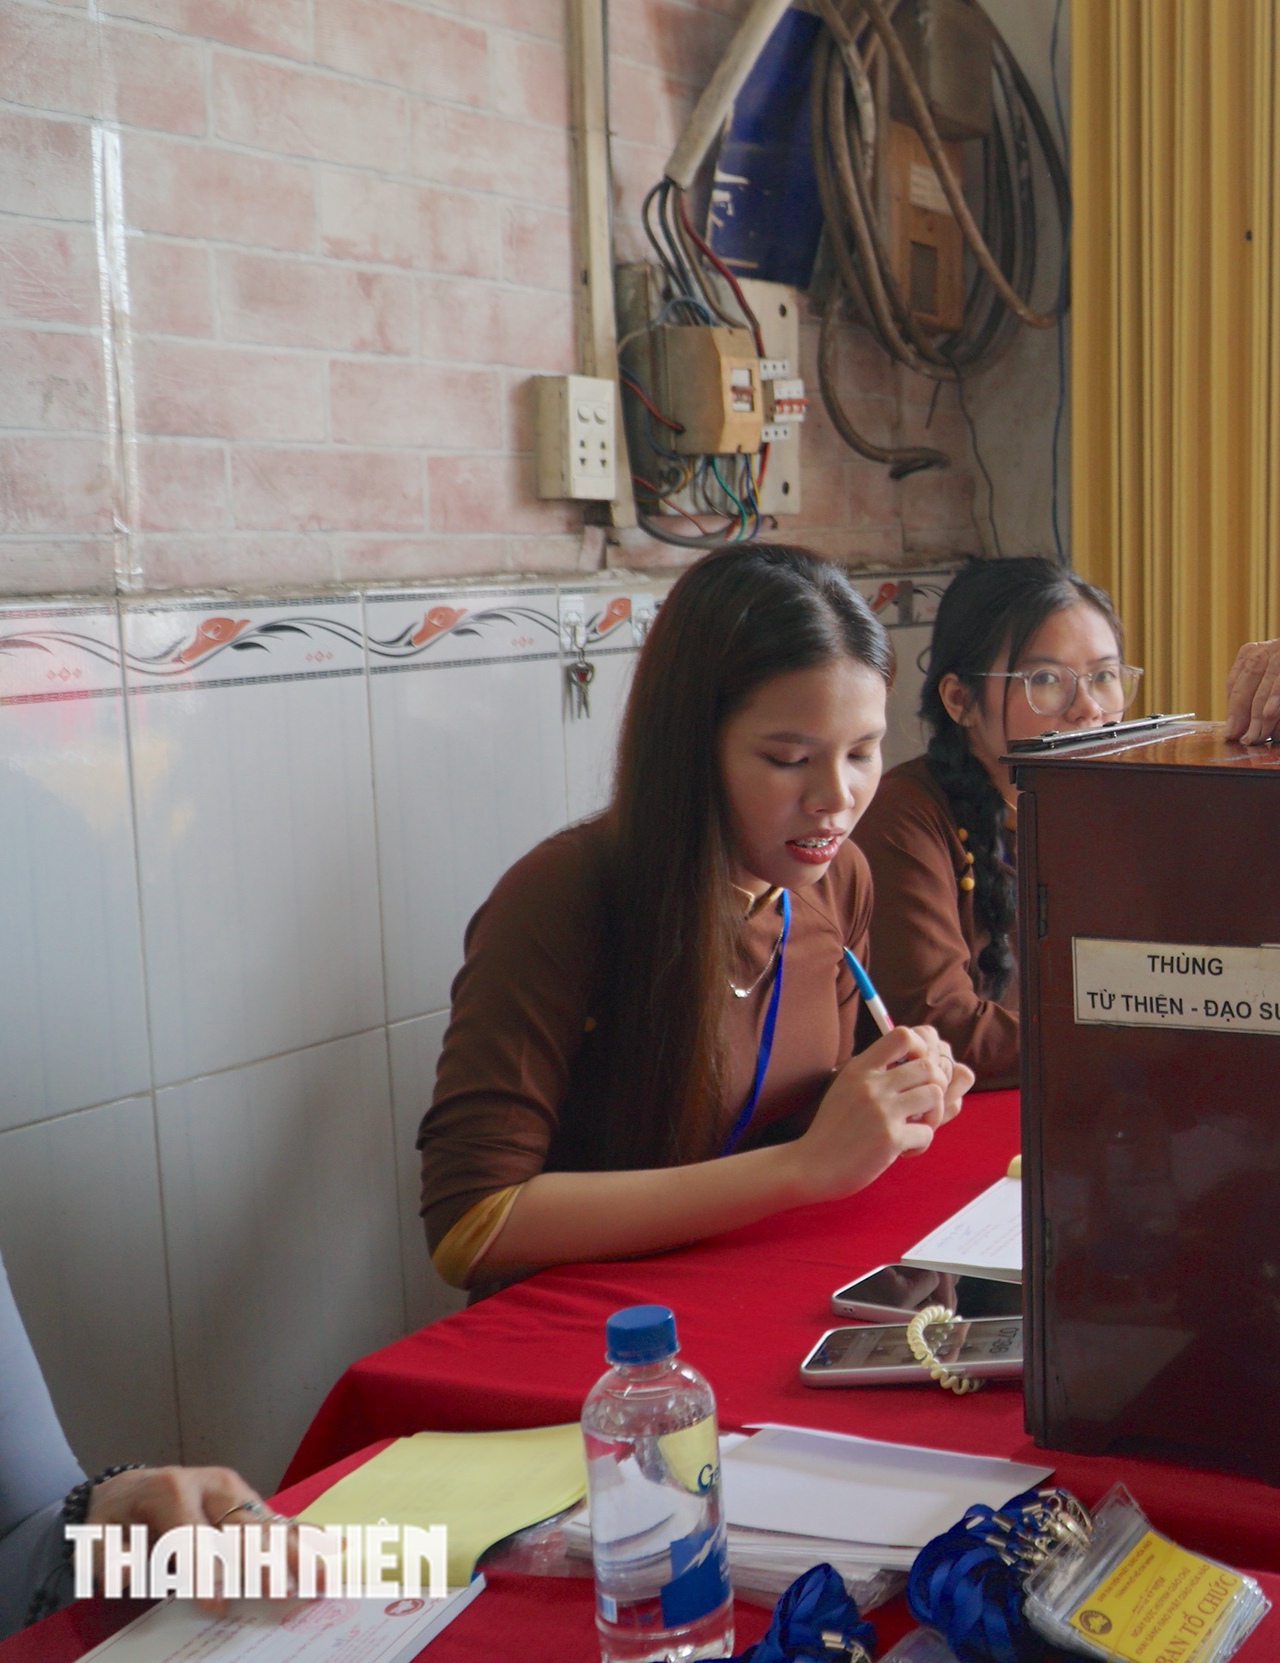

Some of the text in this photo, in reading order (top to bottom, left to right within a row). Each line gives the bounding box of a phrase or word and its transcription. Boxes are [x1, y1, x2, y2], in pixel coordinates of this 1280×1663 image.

[1147, 952, 1223, 976] THÙNG
[1087, 989, 1116, 1010] TỪ
[1121, 994, 1184, 1017] THIỆN
[1204, 1000, 1252, 1022] ĐẠO
[1179, 1612, 1205, 1636] TỔ
[1198, 1575, 1237, 1615] CHỨC
